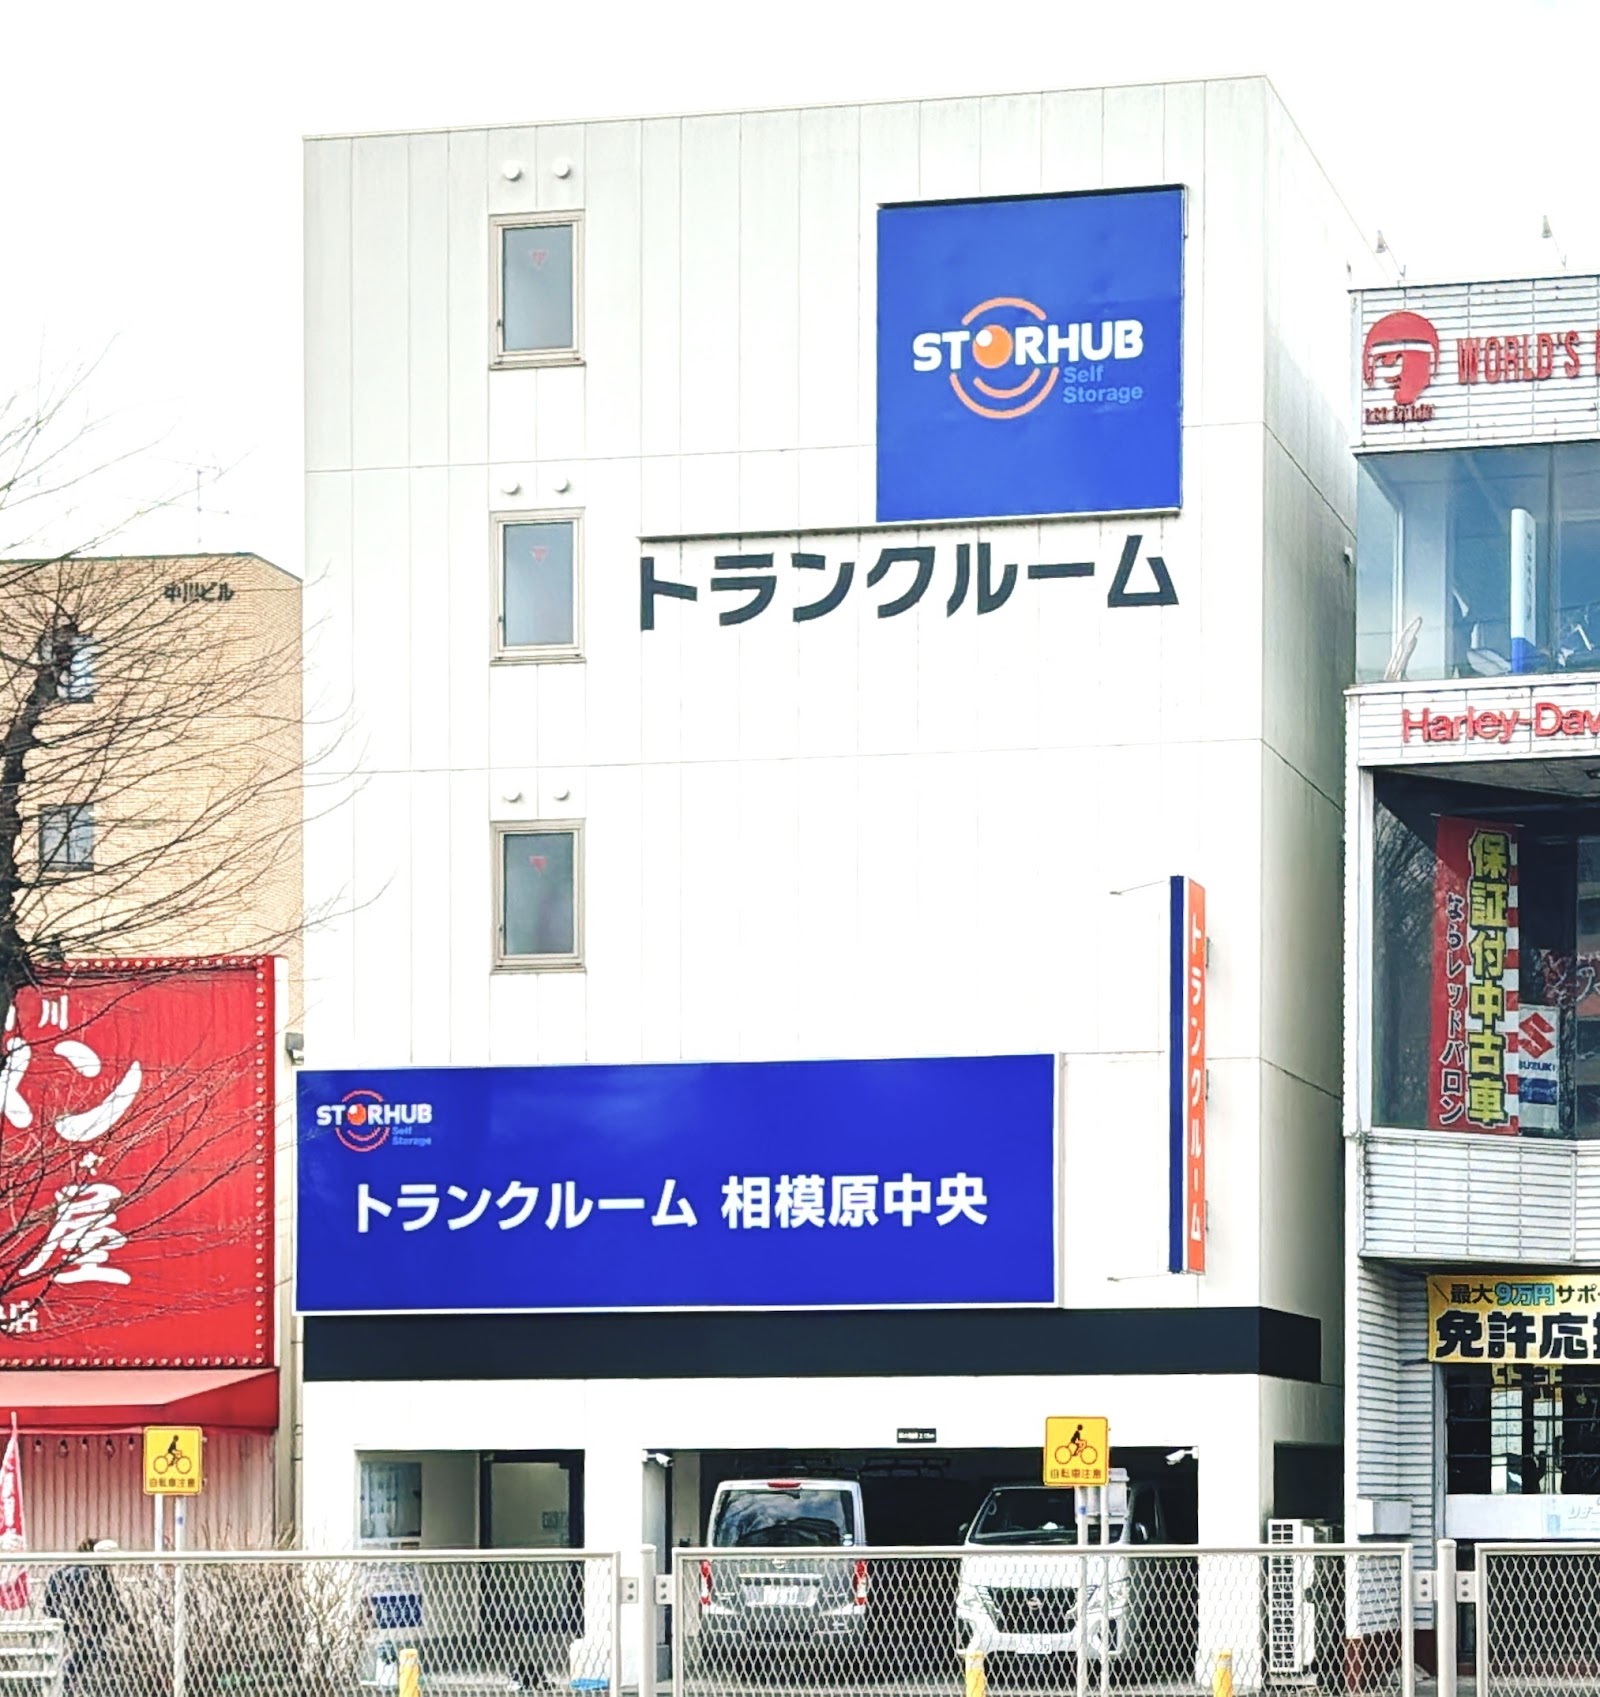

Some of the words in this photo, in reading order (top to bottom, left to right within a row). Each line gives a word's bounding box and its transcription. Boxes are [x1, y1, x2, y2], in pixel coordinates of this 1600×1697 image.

[913, 320, 1143, 371] STORHUB
[1457, 331, 1580, 384] WORLD'S
[1063, 365, 1104, 384] Self
[1063, 386, 1143, 404] Storage
[640, 535, 1179, 631] トランクルーム
[1467, 831, 1510, 1125] 保証付中古車
[1439, 893, 1464, 1125] ならレッドバロン
[1190, 913, 1202, 1241] トランクルーム
[316, 1104, 432, 1126] STORHUB
[355, 1178, 697, 1233] トランクルーム
[721, 1173, 988, 1230] 相模原中央
[1451, 1282, 1600, 1306] 最大9万円サポ
[1435, 1309, 1600, 1359] 免許応
